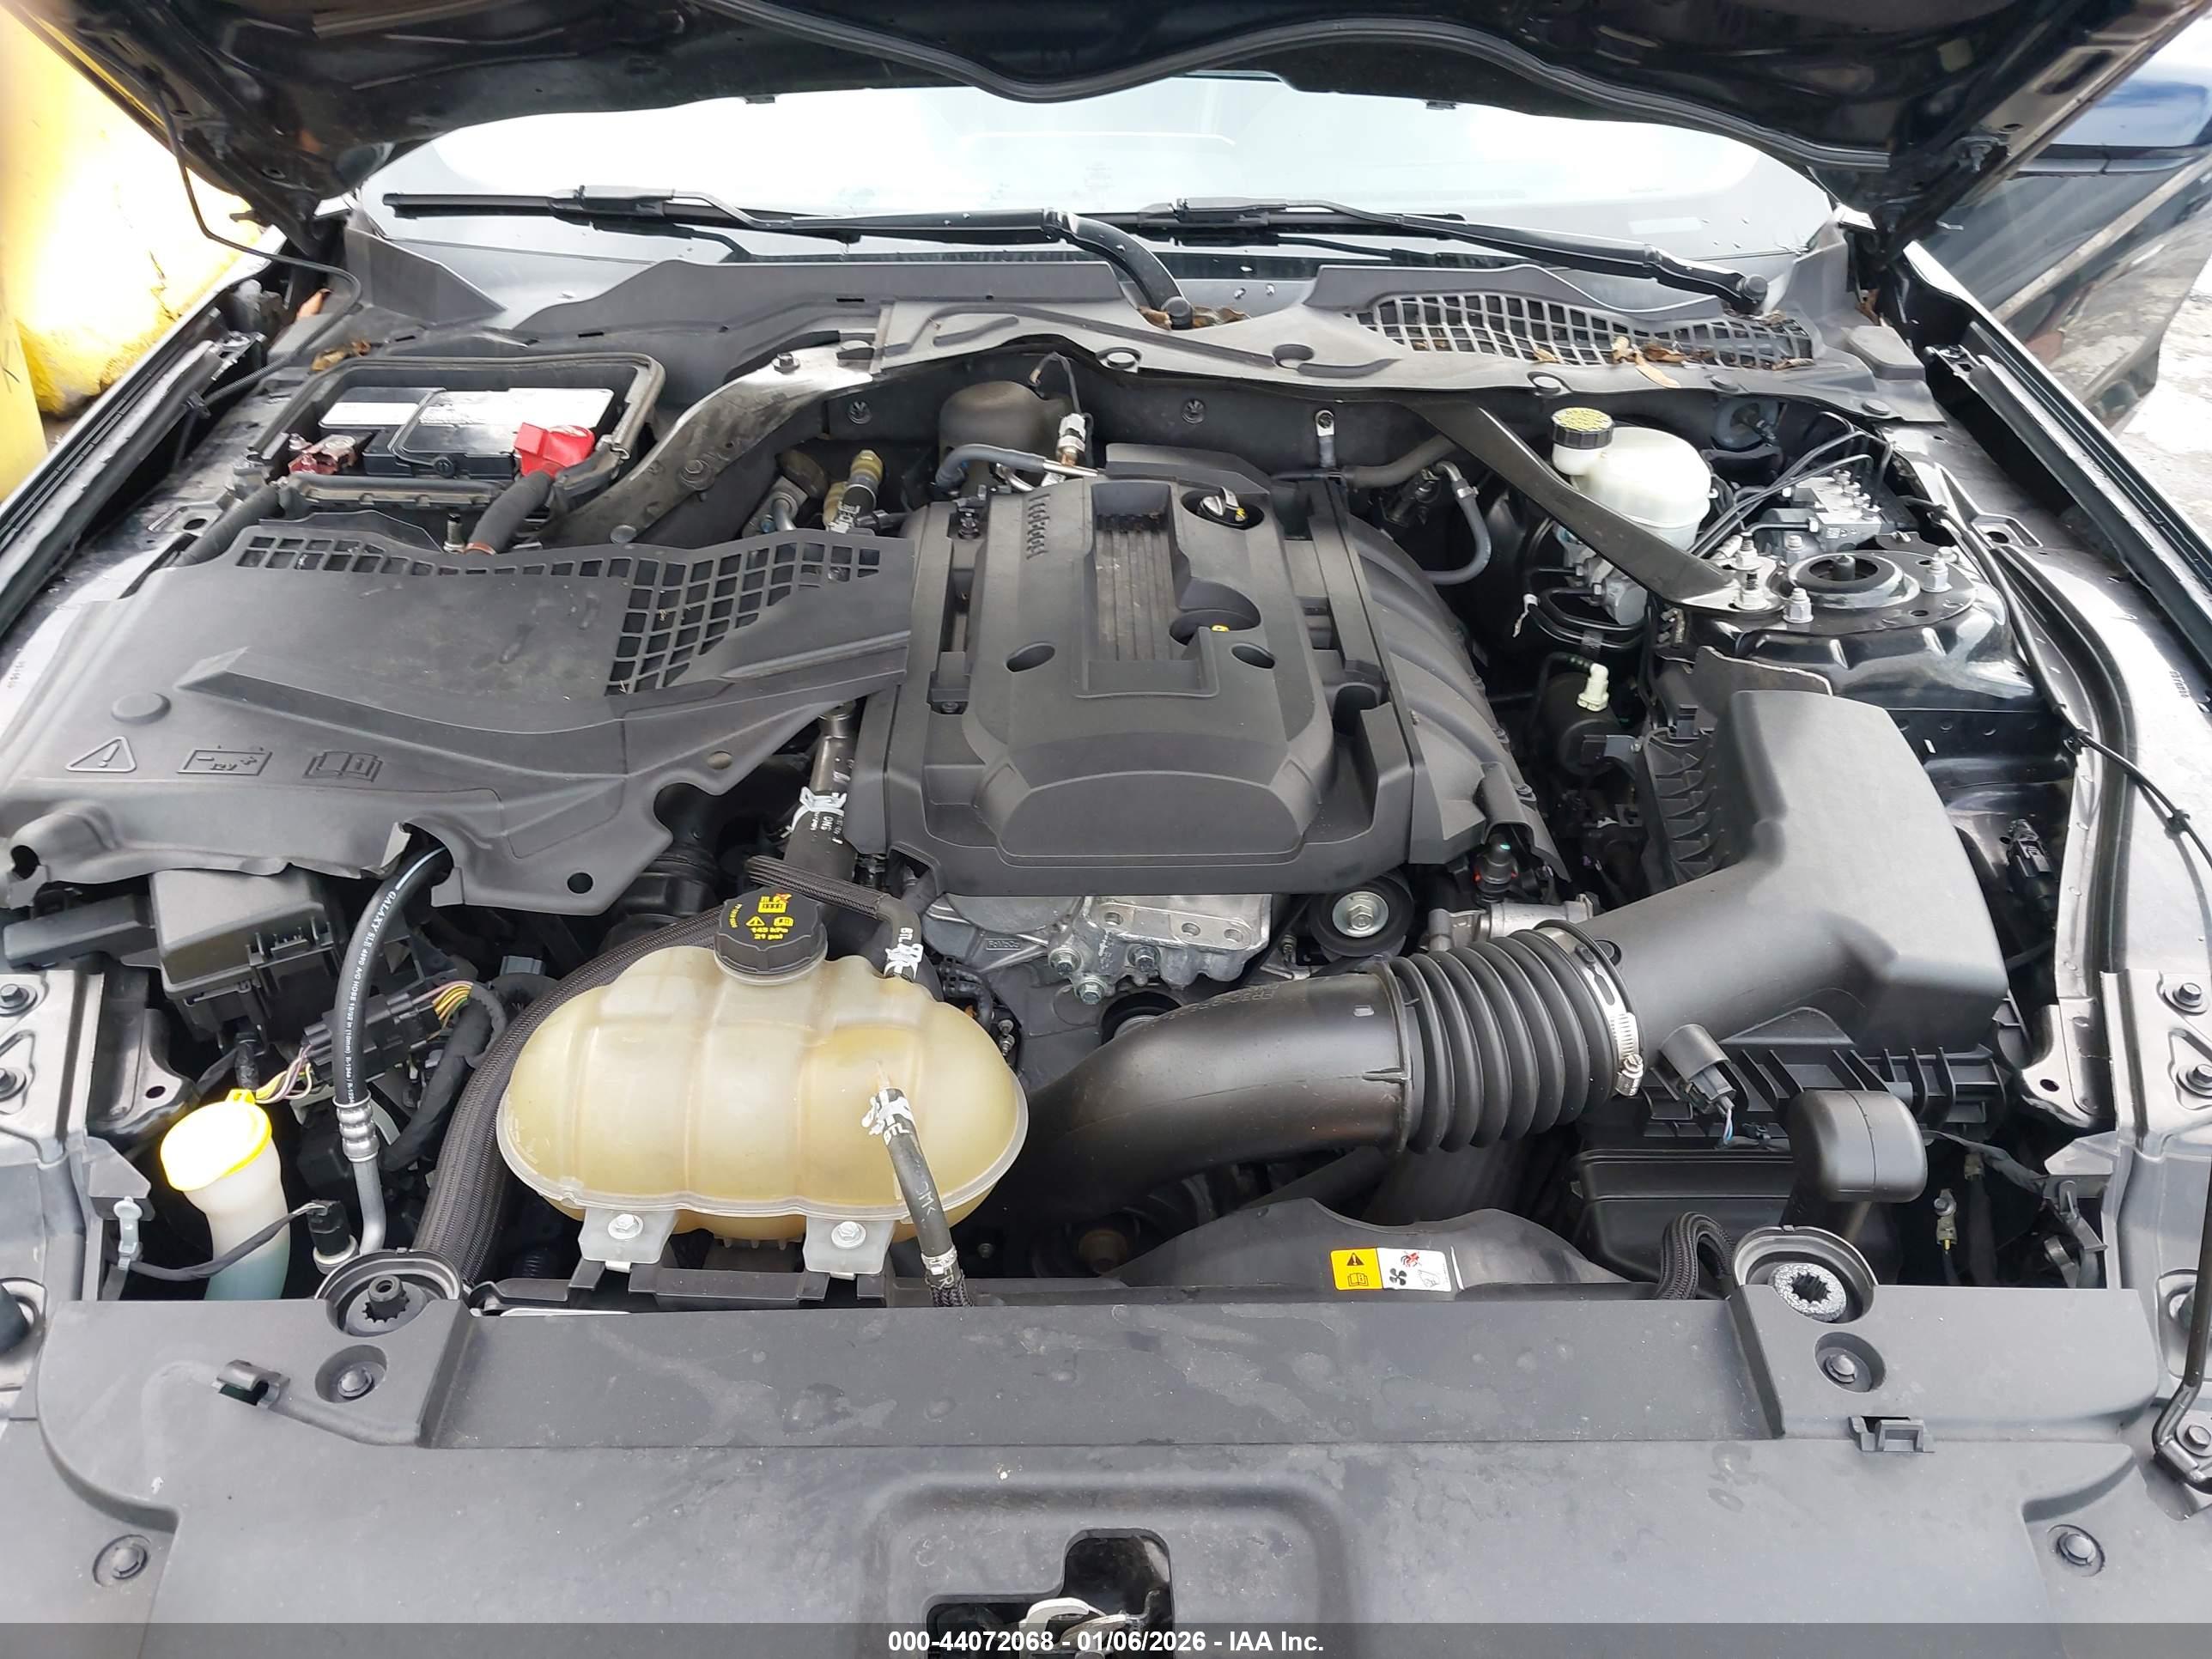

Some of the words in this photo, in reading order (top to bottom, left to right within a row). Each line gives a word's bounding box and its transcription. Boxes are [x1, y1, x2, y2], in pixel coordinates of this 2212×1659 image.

[371, 890, 397, 933] GALAXY
[349, 981, 360, 1001] HOSE
[884, 1122, 911, 1146] BTL
